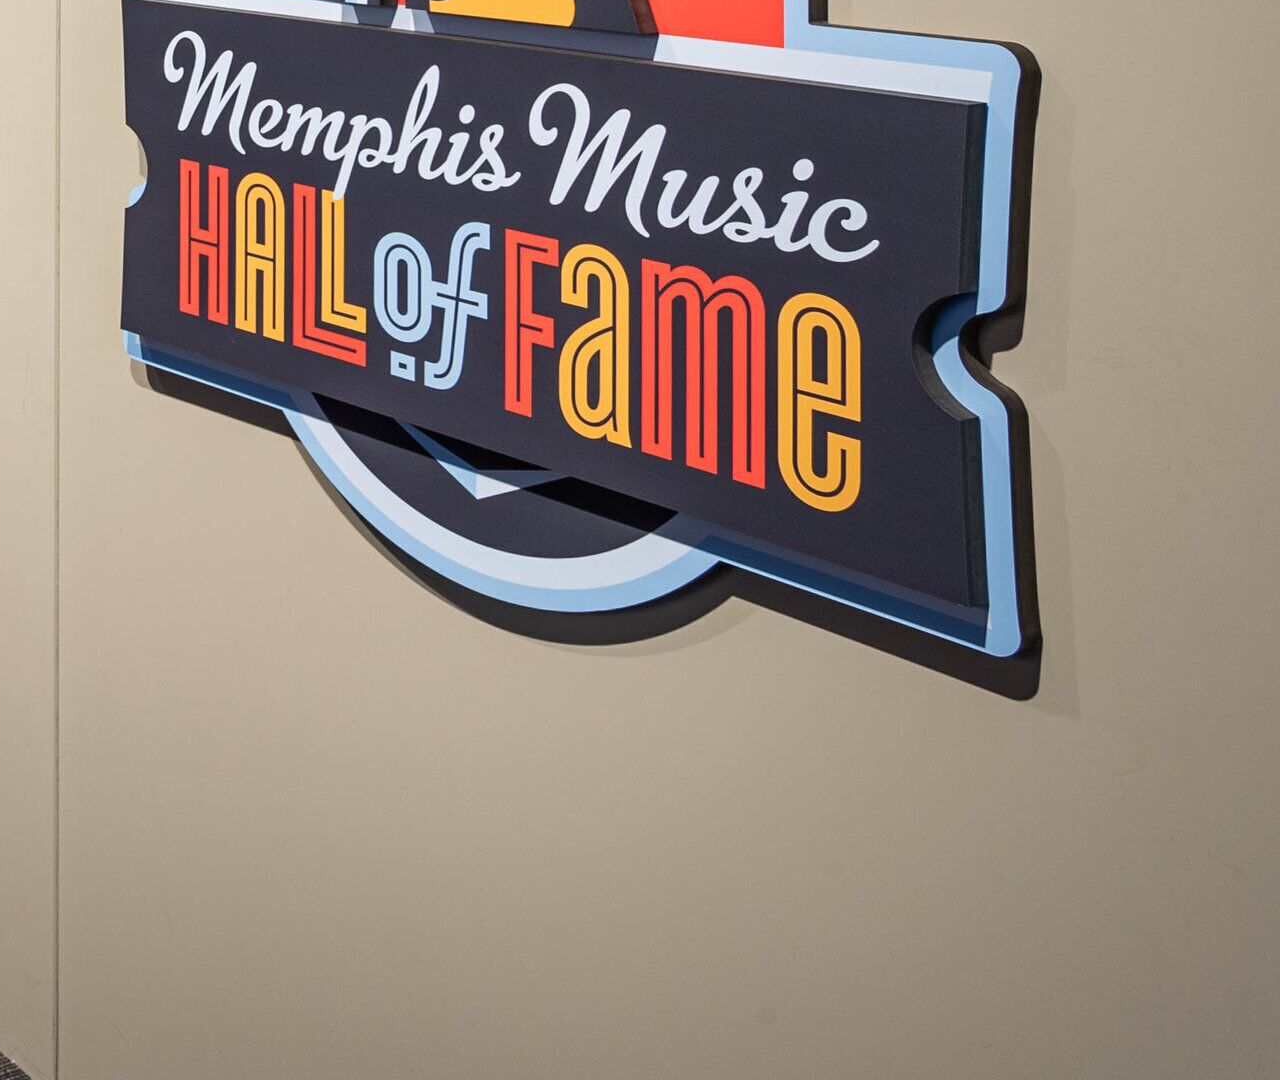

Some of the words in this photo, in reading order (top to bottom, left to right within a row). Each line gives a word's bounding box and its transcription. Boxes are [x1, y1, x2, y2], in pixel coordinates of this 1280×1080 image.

[164, 31, 521, 200] Memphis
[529, 83, 879, 262] Music
[180, 159, 366, 367] HALL
[374, 221, 491, 391] of
